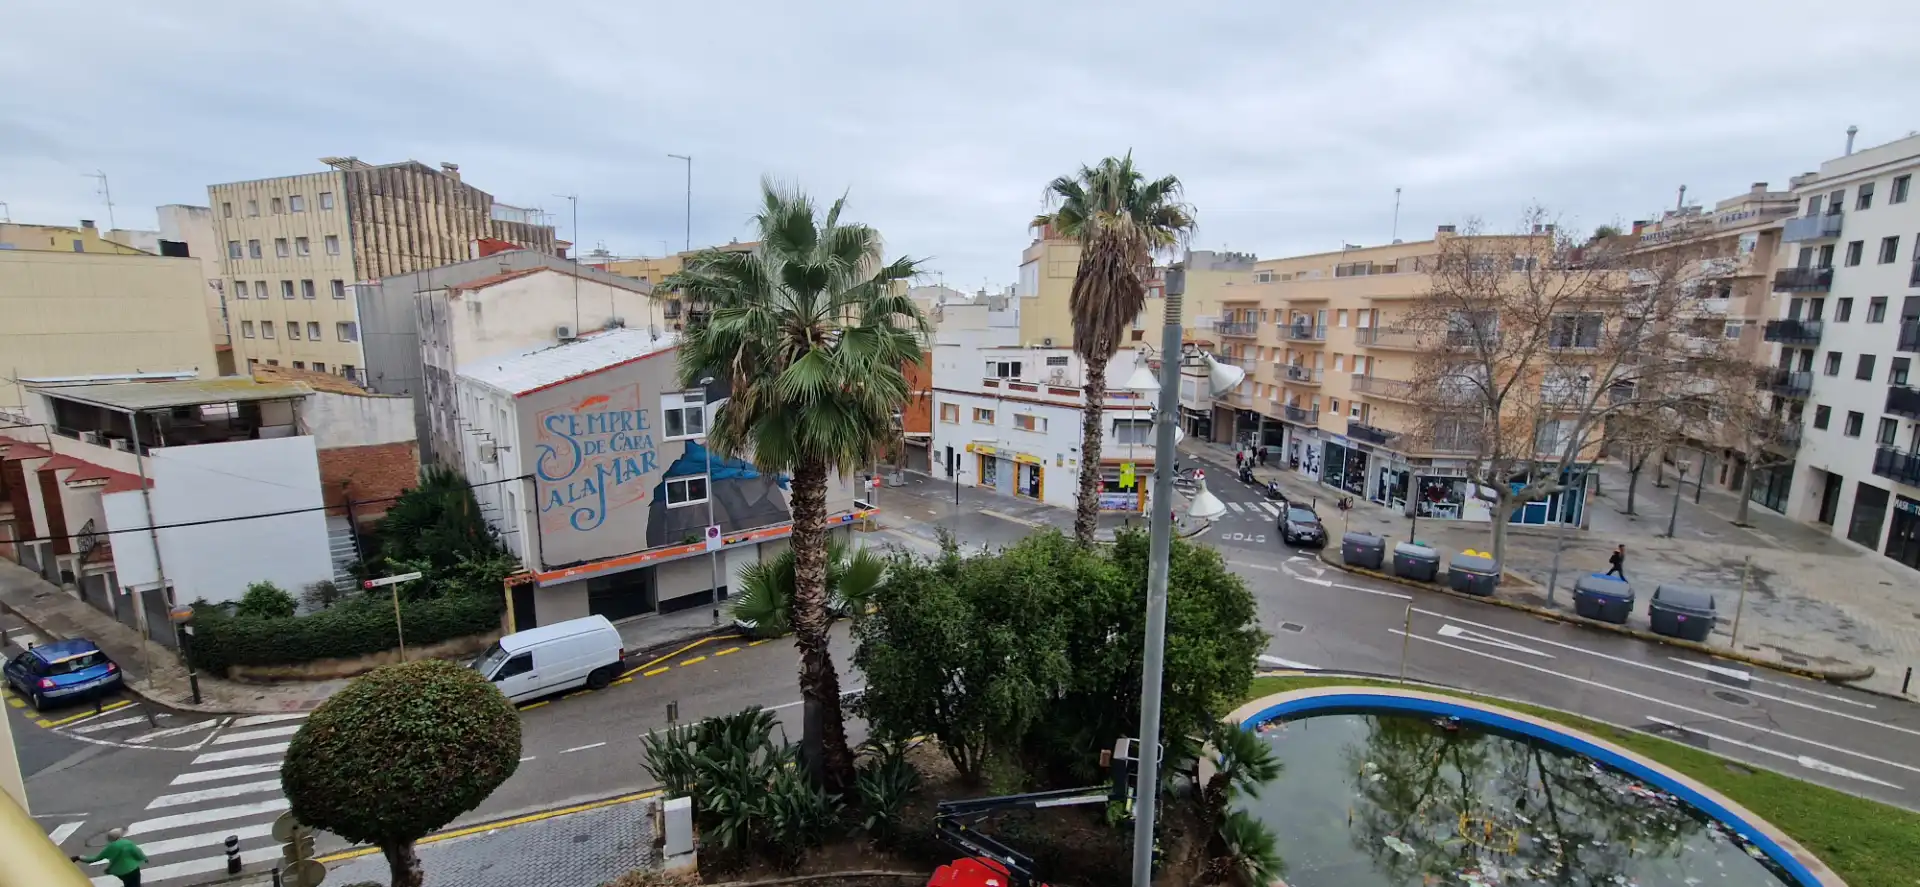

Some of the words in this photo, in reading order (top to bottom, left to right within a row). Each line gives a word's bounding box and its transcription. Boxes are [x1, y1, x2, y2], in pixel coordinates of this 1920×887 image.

[536, 409, 651, 481] SEMPRE
[584, 440, 606, 456] DE
[610, 432, 655, 452] CARA
[570, 450, 659, 531] MAR
[1221, 532, 1266, 543] STOP
